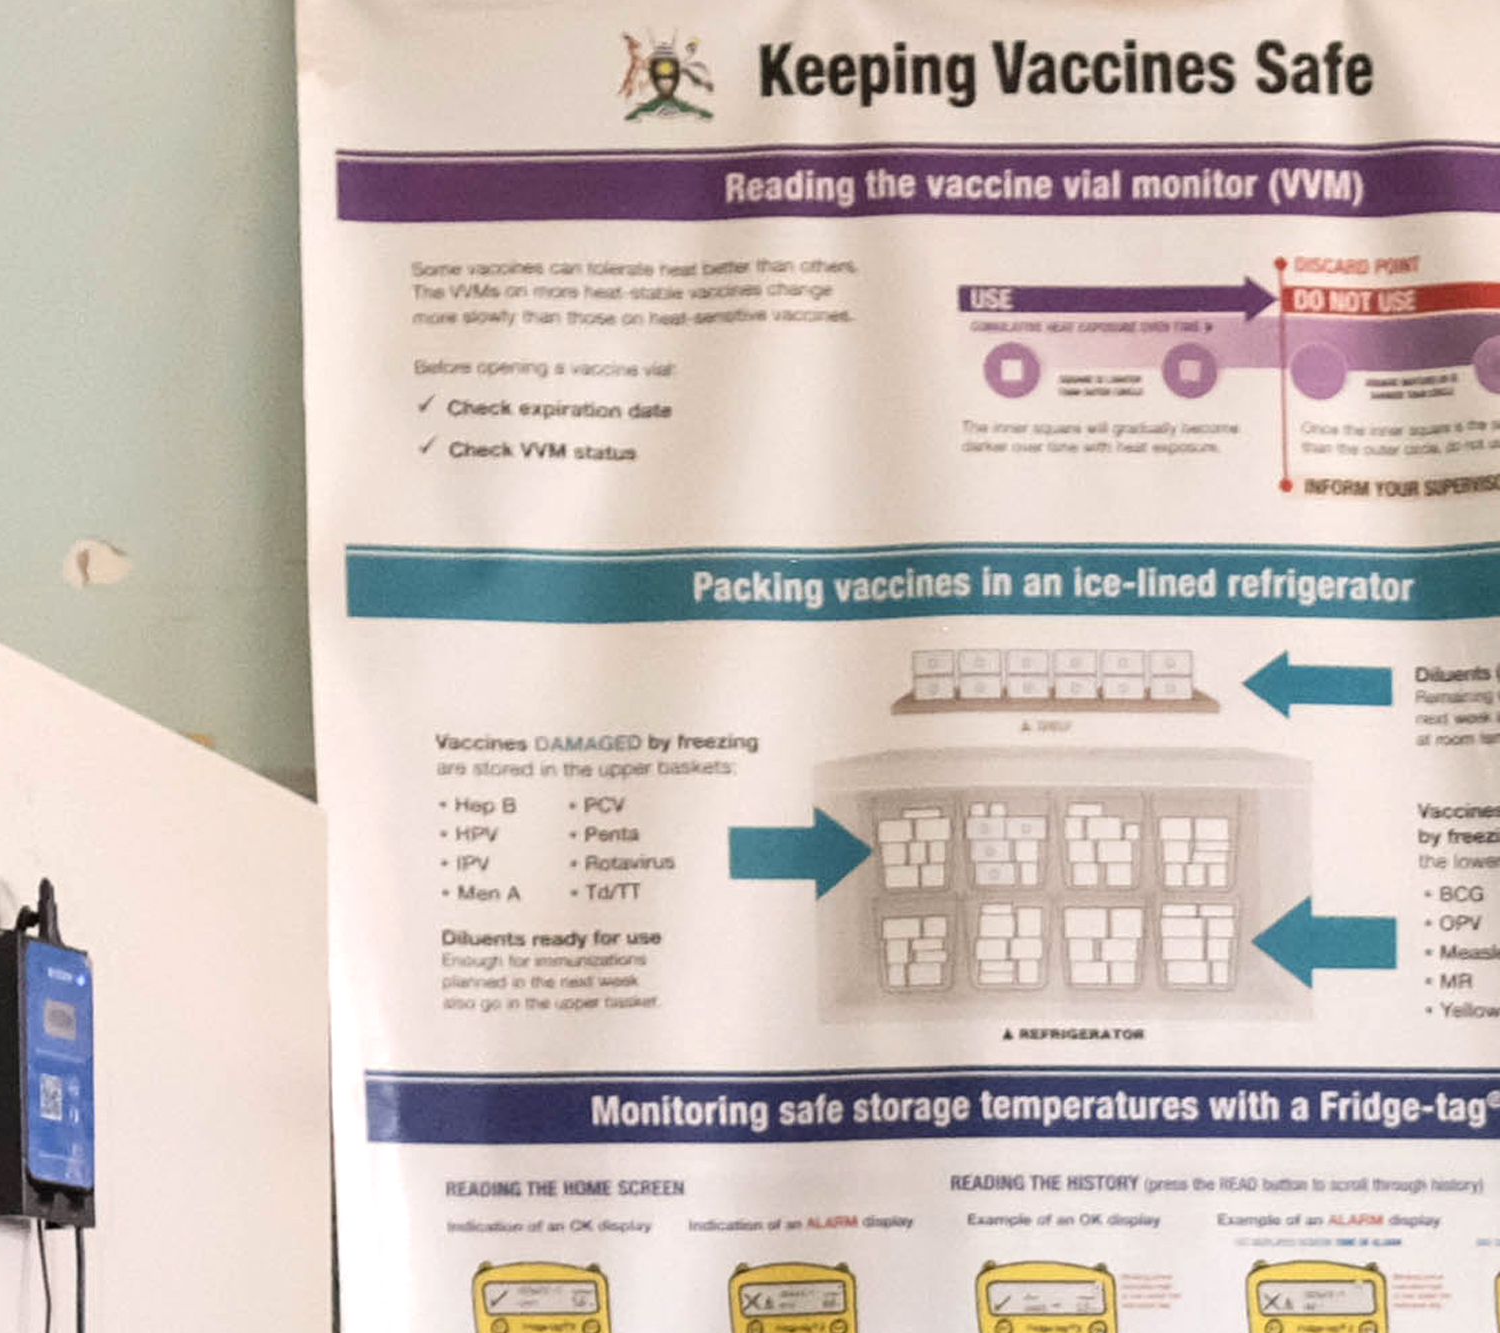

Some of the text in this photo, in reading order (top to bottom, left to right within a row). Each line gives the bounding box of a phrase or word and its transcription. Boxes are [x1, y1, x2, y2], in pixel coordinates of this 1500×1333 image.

[760, 39, 1373, 108] Keeping Vaccines Safe
[725, 168, 1364, 208] Reading the vaccine vial monitor (VVM)
[1293, 256, 1420, 275] DISCARD POINT
[970, 288, 1012, 311] USE
[1294, 288, 1415, 312] DO NOT USE
[447, 399, 672, 420] Check expiration date
[449, 441, 637, 461] Check VVM status
[1304, 478, 1370, 496] INFORM
[1375, 480, 1420, 498] YOUR
[693, 566, 1415, 609] Packing vaccines in an ice-lined refrigerator
[435, 734, 759, 754] Vaccines DAMAGED by freezing
[455, 797, 517, 816] Hep B
[584, 796, 625, 814] PCV
[455, 826, 498, 843] HPV
[584, 826, 640, 842] Penta
[457, 855, 490, 872] IPV
[585, 855, 675, 872] Rotavirus
[458, 885, 521, 901] Men A
[586, 882, 641, 900] Td/TT
[1440, 885, 1485, 903] BCG
[1439, 915, 1482, 931] OPV
[442, 929, 662, 949] Diluents ready for use
[1440, 973, 1473, 988] MR
[1440, 1003, 1500, 1018] Yellow
[592, 1095, 768, 1132] Monitoring
[779, 1094, 843, 1125] safe
[853, 1093, 970, 1127] storage
[980, 1090, 1199, 1127] temperatures
[1209, 1090, 1279, 1121] with
[1291, 1097, 1309, 1121] a
[446, 1180, 685, 1197] READING THE HOME SCREEN
[950, 1174, 1139, 1191] READING THE HISTORY
